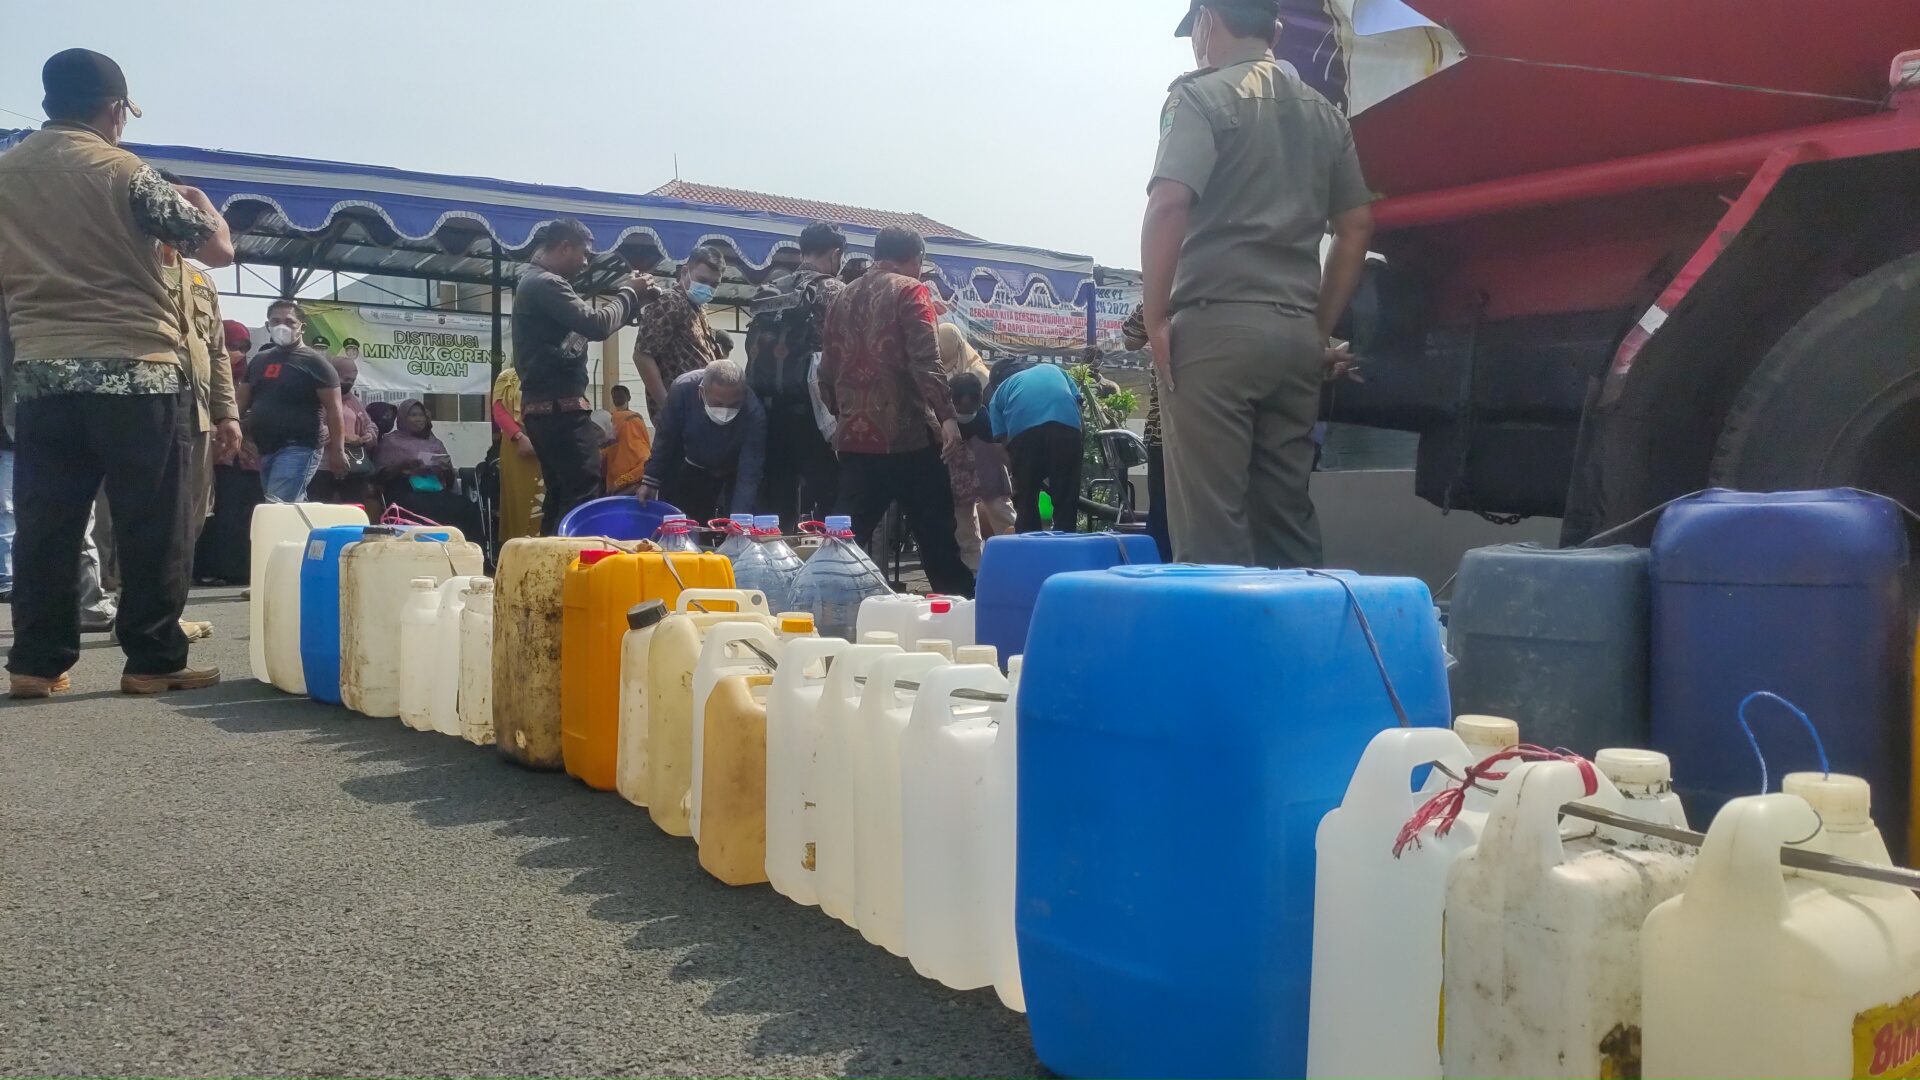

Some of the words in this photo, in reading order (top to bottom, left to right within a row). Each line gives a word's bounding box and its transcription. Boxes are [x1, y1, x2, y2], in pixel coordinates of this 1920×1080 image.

[970, 307, 999, 319] BERSAMA
[1014, 311, 1041, 324] BERSATU
[1107, 302, 1129, 315] 2022
[994, 321, 1007, 332] DAN
[1008, 323, 1026, 334] DAPAT
[394, 330, 479, 347] DISTRIBUSI
[363, 343, 435, 360] MINYAK
[407, 361, 468, 376] CURAH
[1868, 1019, 1920, 1076] Bim
